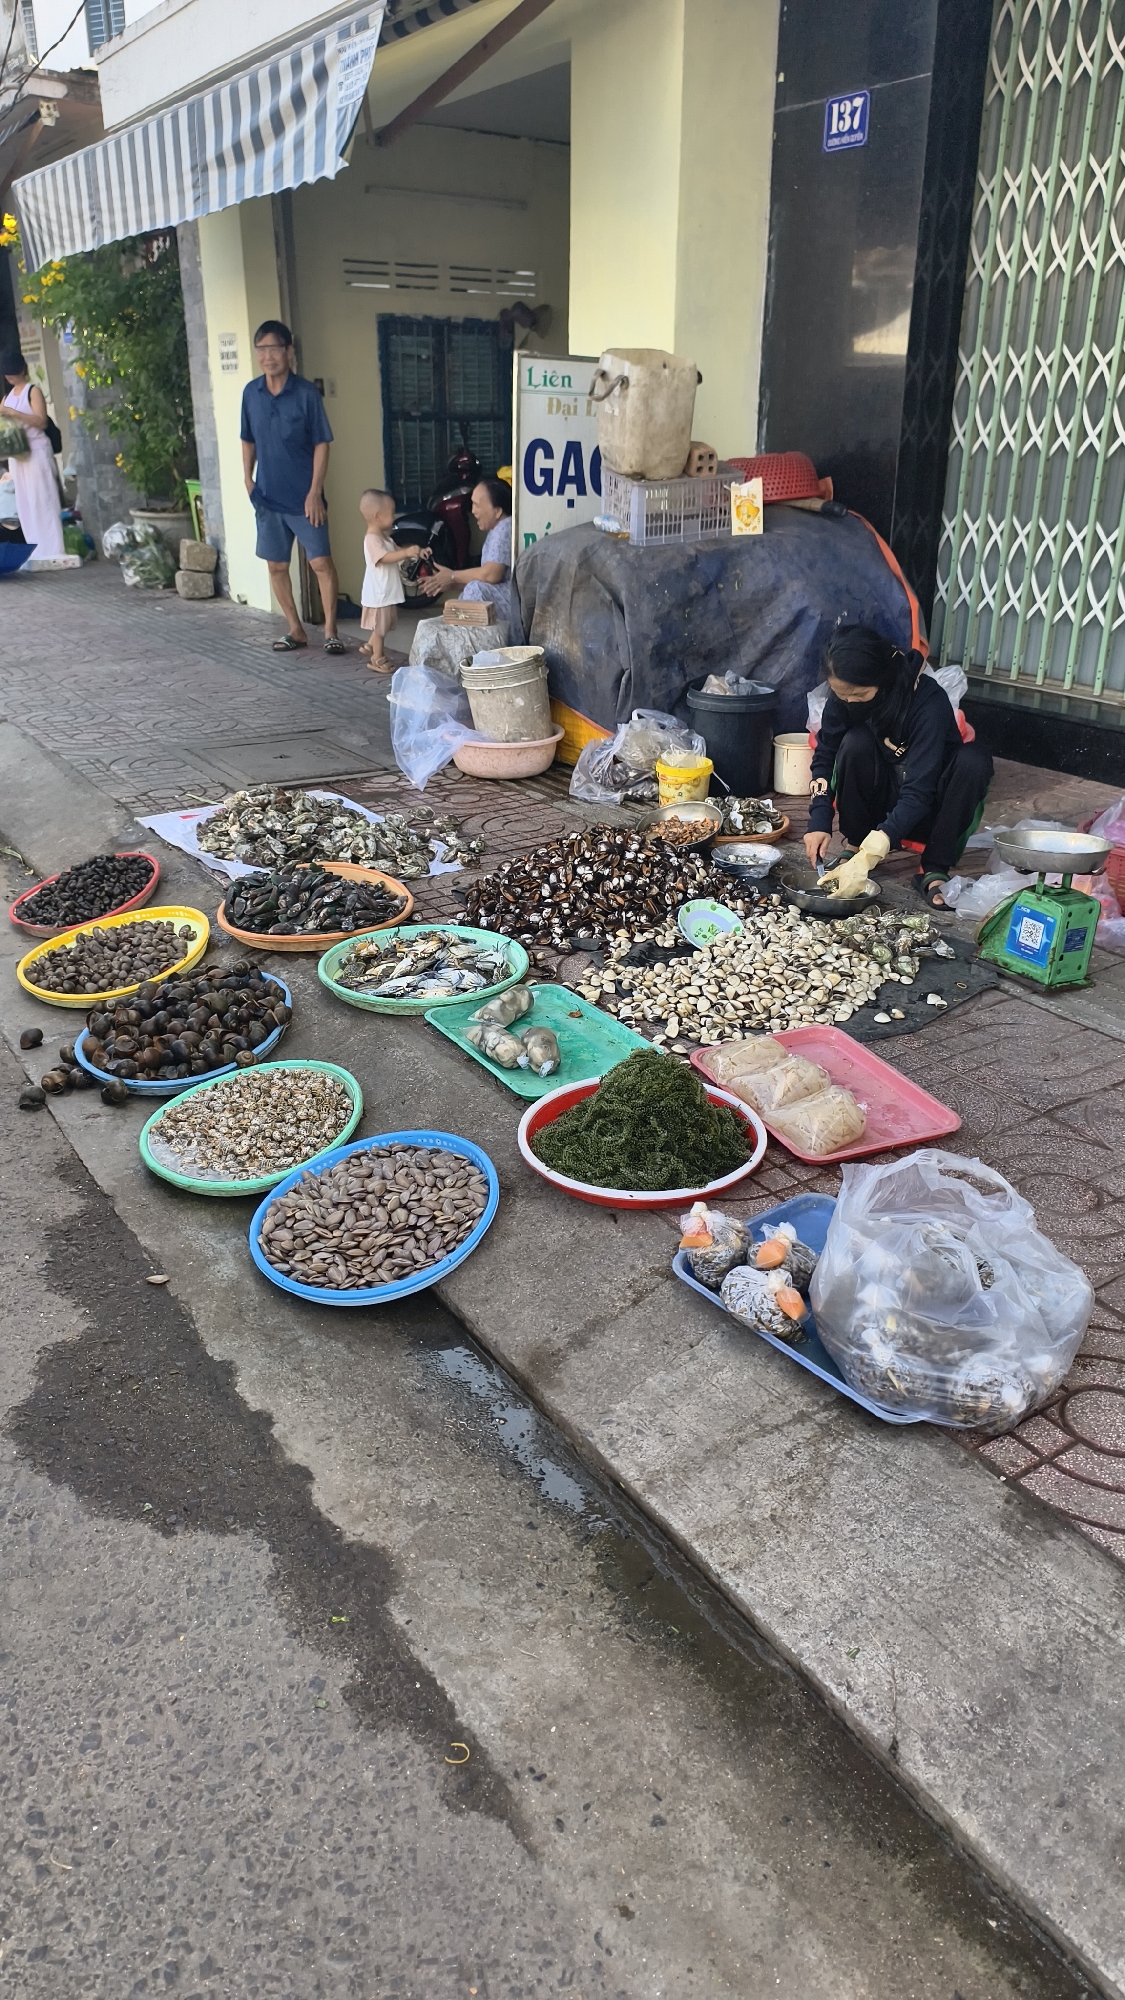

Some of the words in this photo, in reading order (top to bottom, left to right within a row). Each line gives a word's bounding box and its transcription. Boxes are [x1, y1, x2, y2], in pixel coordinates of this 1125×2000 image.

[829, 97, 865, 135] 137
[527, 366, 573, 389] Liên
[585, 399, 597, 418] L
